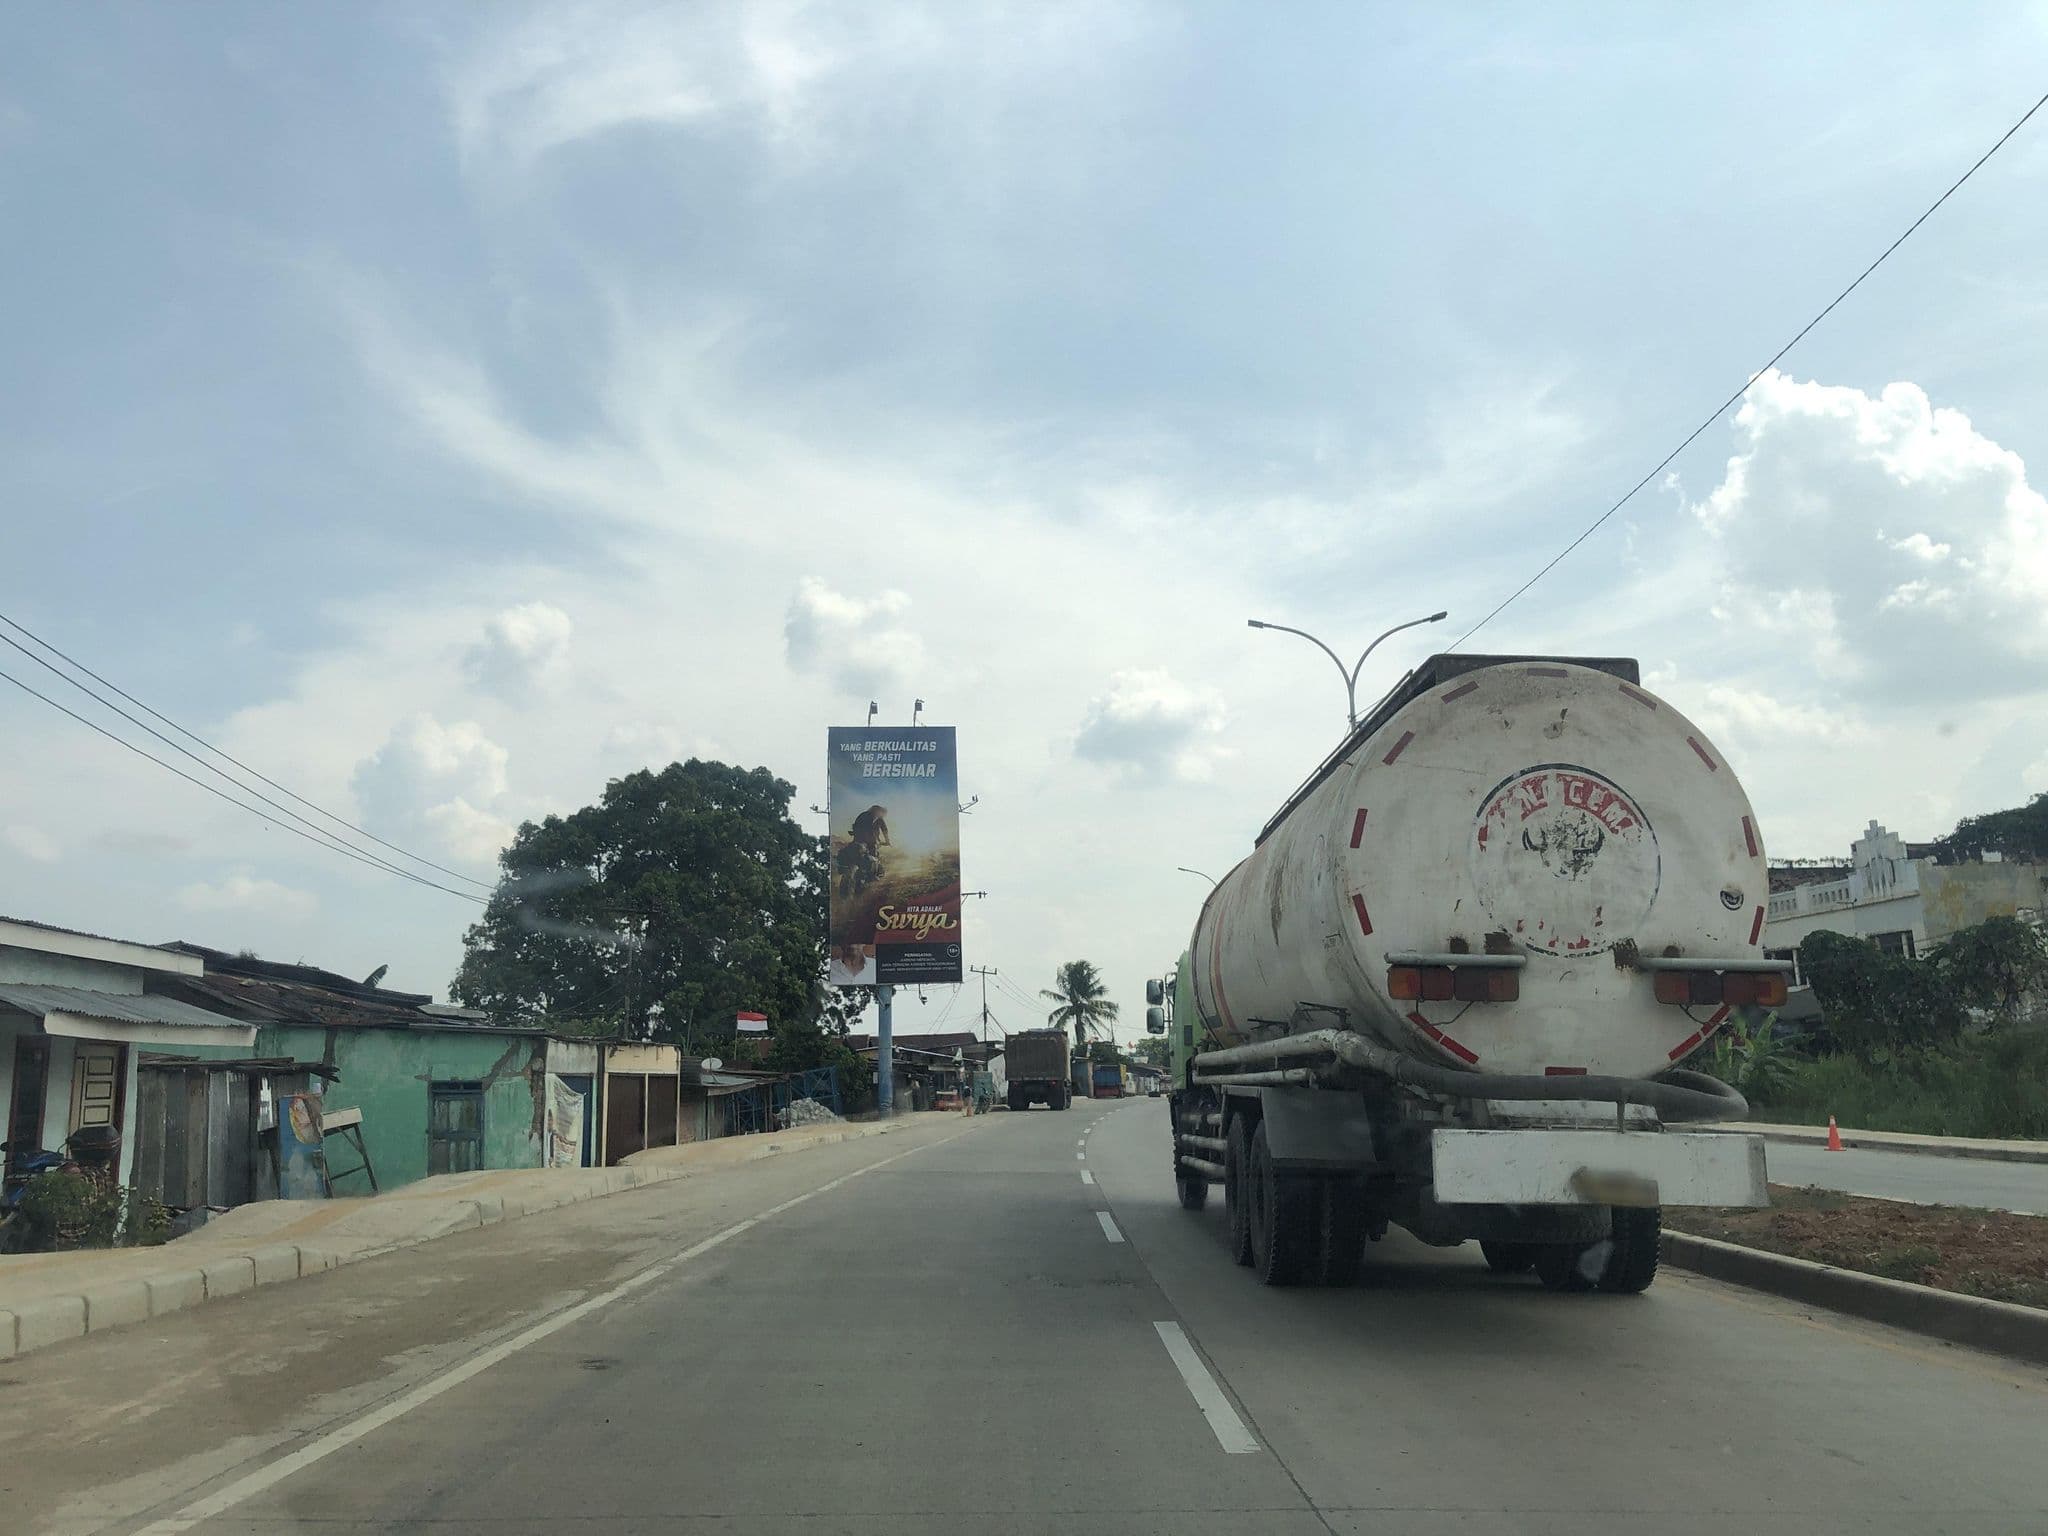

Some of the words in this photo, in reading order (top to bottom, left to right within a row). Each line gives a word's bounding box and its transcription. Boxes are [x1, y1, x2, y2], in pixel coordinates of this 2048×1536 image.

[840, 743, 862, 752] YANG
[864, 741, 937, 752] BERKUALITAS
[852, 753, 874, 762] YANG
[876, 753, 901, 762] PASTI
[863, 763, 936, 777] BERSINAR
[875, 905, 958, 940] Surya
